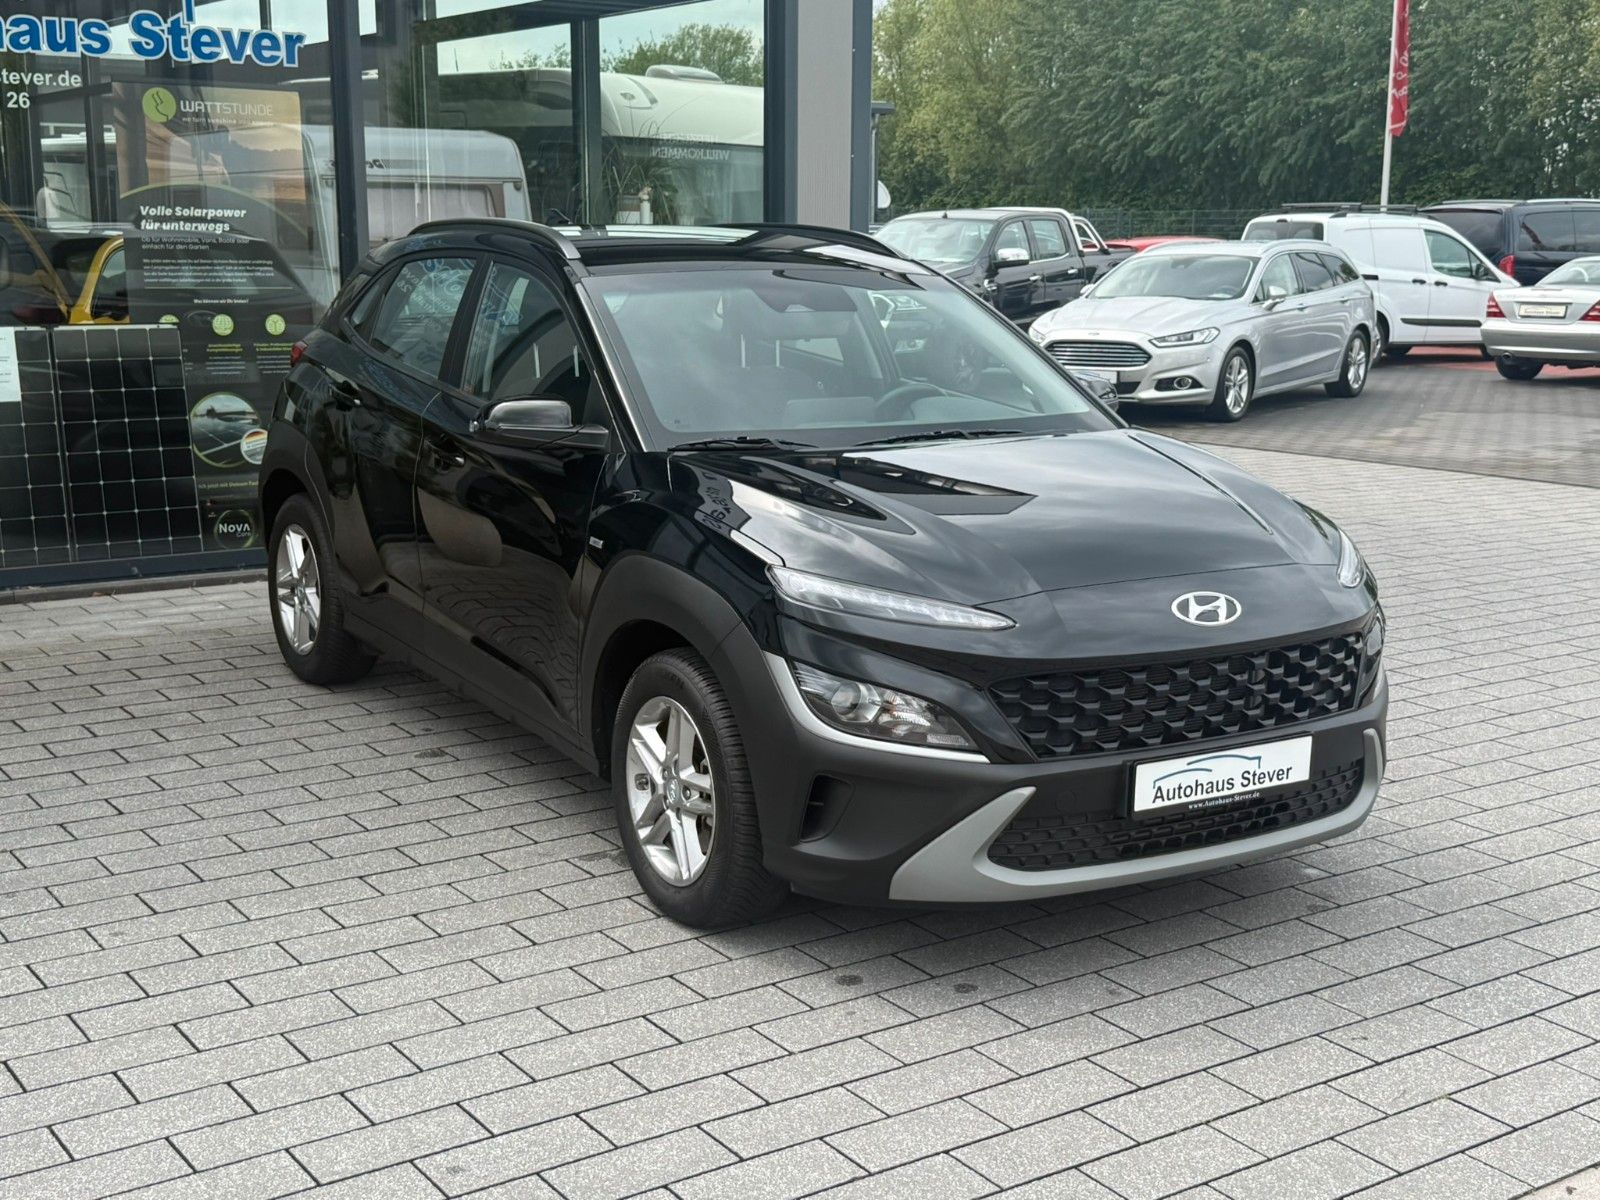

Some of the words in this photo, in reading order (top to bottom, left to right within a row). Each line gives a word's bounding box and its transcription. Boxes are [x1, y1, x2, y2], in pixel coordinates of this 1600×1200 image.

[0, 14, 112, 57] aus
[128, 9, 306, 68] Stever
[0, 68, 83, 87] tever.de
[7, 92, 31, 109] 26
[180, 100, 273, 116] WATTSTUNDE
[140, 205, 172, 217] Volle
[174, 206, 247, 220] Solarpower
[140, 220, 161, 230] für
[162, 221, 230, 234] unterwegs
[1152, 776, 1235, 804] Autohaus
[1240, 765, 1293, 788] Stever
[1188, 792, 1260, 810] www.Autohaus-Stever.de
